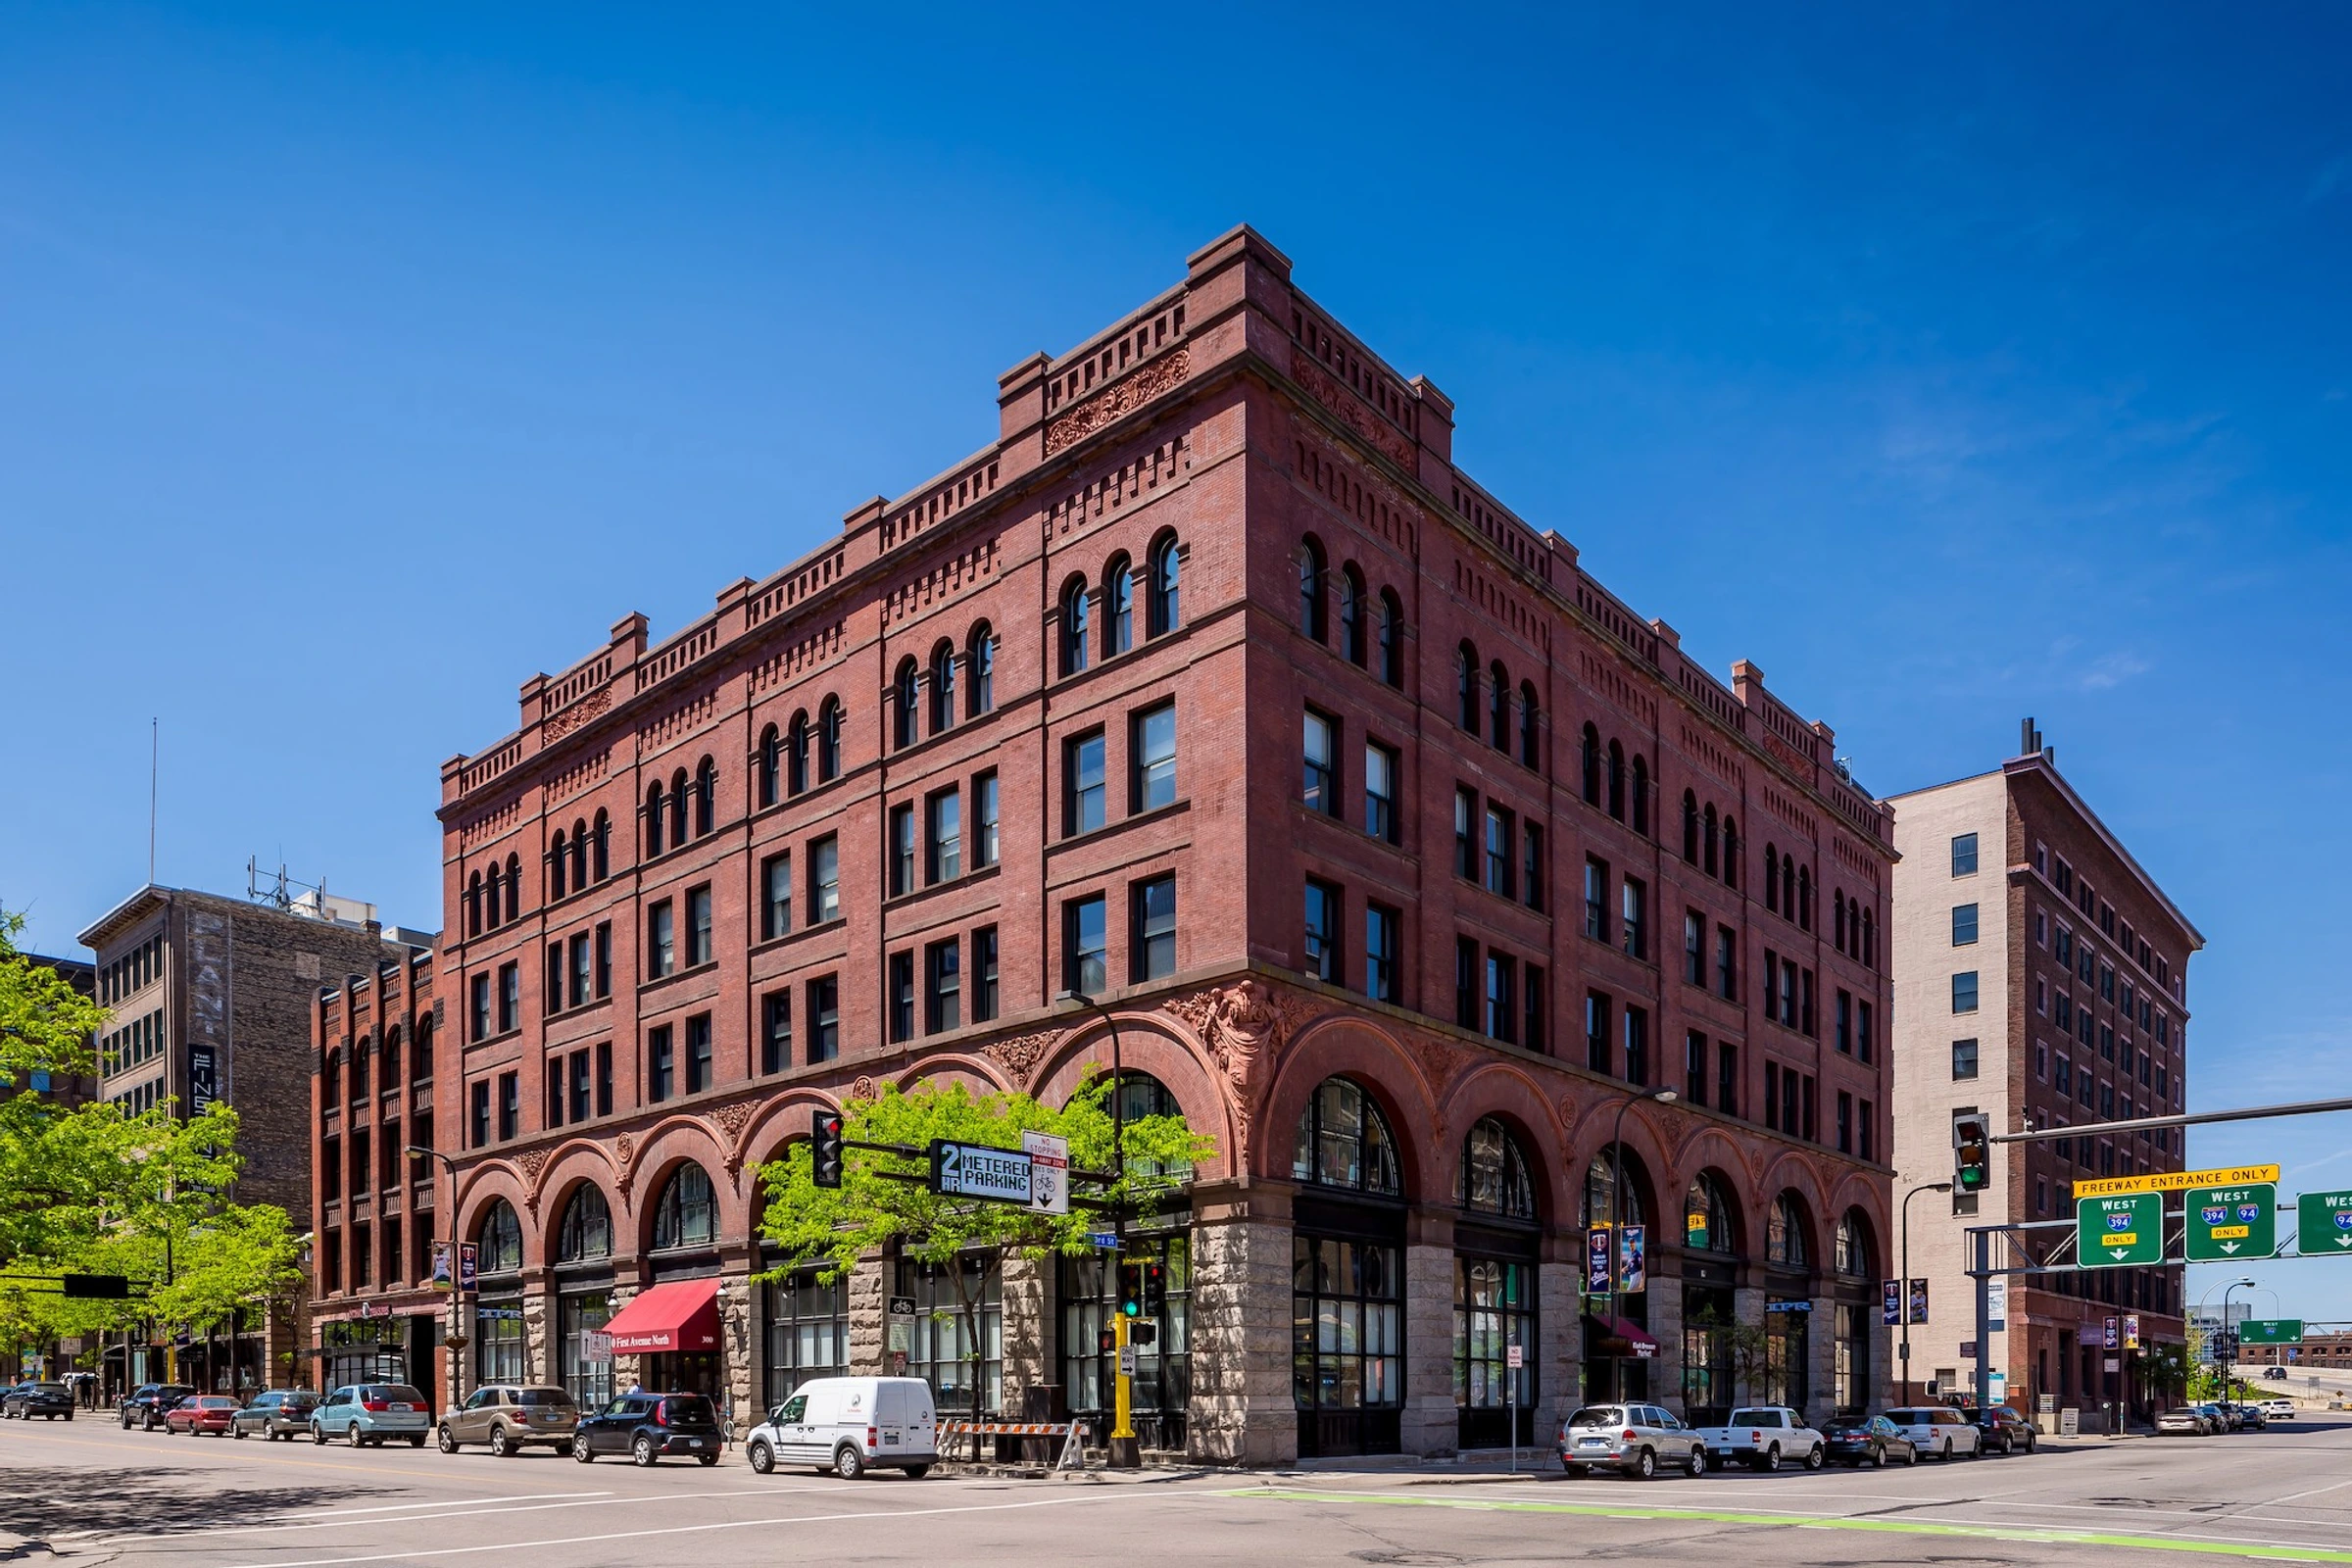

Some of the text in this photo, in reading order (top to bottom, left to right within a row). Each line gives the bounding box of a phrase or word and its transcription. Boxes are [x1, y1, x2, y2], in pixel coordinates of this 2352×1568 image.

[1029, 1144, 1062, 1156] STOPPING
[942, 1144, 959, 1175] 2
[962, 1154, 1031, 1176] METERED
[943, 1177, 960, 1193] HR
[965, 1170, 1027, 1191] PARKING
[2082, 1168, 2270, 1194] FREEWAY ENTRANCE ONLY
[2211, 1191, 2250, 1202] WEST
[2325, 1196, 2352, 1207] WE
[2101, 1200, 2137, 1210] WEST
[2205, 1211, 2225, 1221] 394
[2240, 1208, 2255, 1218] 94
[2110, 1218, 2128, 1227] 394
[2337, 1215, 2352, 1225] 94
[2216, 1228, 2244, 1237] ONLY
[1095, 1236, 1105, 1245] 3rd
[2105, 1235, 2132, 1244] ONLY
[616, 1337, 629, 1348] First
[630, 1336, 652, 1347] Avenue
[652, 1334, 669, 1345] North
